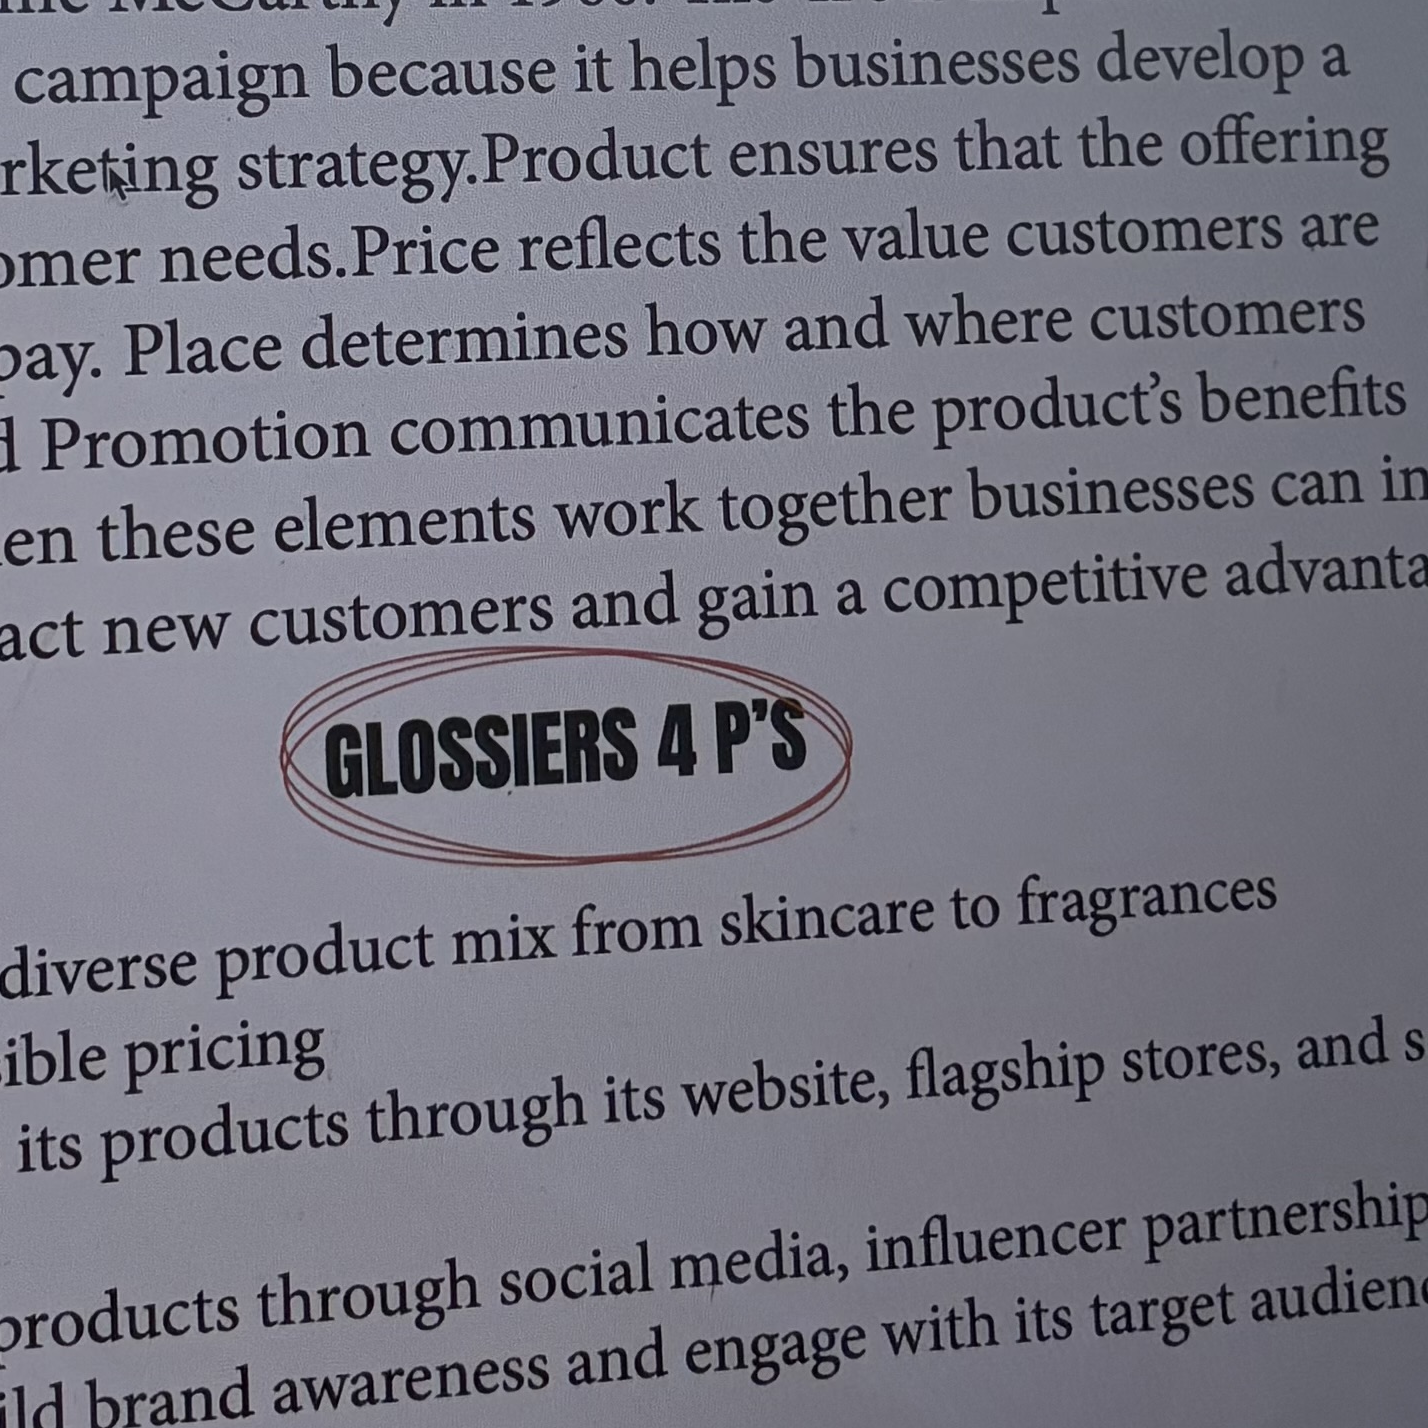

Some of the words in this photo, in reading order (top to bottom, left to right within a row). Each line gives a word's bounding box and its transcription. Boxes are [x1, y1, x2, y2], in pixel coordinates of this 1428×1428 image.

[730, 138, 937, 177] ensures
[954, 118, 1062, 171] that
[1078, 116, 1162, 168] the
[1181, 112, 1390, 178] offering
[124, 318, 281, 375] Place
[302, 312, 628, 369] determines
[645, 302, 767, 355] how
[785, 295, 890, 351] and
[904, 292, 1072, 347] where
[1091, 295, 1365, 341] customers
[97, 504, 254, 562] these
[275, 495, 535, 552] elements
[553, 479, 704, 539] work
[717, 470, 952, 546] together
[967, 466, 1254, 520] businesses
[1272, 470, 1364, 506] can
[103, 612, 231, 655] new
[250, 595, 553, 646] customers
[572, 569, 680, 629] and
[698, 569, 818, 640] gain
[837, 579, 867, 615] a
[884, 552, 1207, 624] competitive
[325, 707, 638, 799] GLOSSIERS
[658, 703, 697, 776] 4
[714, 697, 808, 775] P’S
[215, 921, 435, 1000] product
[452, 914, 557, 965] mix
[572, 903, 703, 956] from
[721, 892, 934, 946] skincare
[950, 888, 1000, 929] to
[1017, 874, 1277, 937] fragrances
[124, 1020, 325, 1095] pricing
[273, 1354, 549, 1414] awareness
[568, 1324, 668, 1386] and
[686, 1325, 866, 1386] engage
[881, 1296, 999, 1356] with
[1015, 1297, 1072, 1343] its
[1089, 1283, 1236, 1347] target
